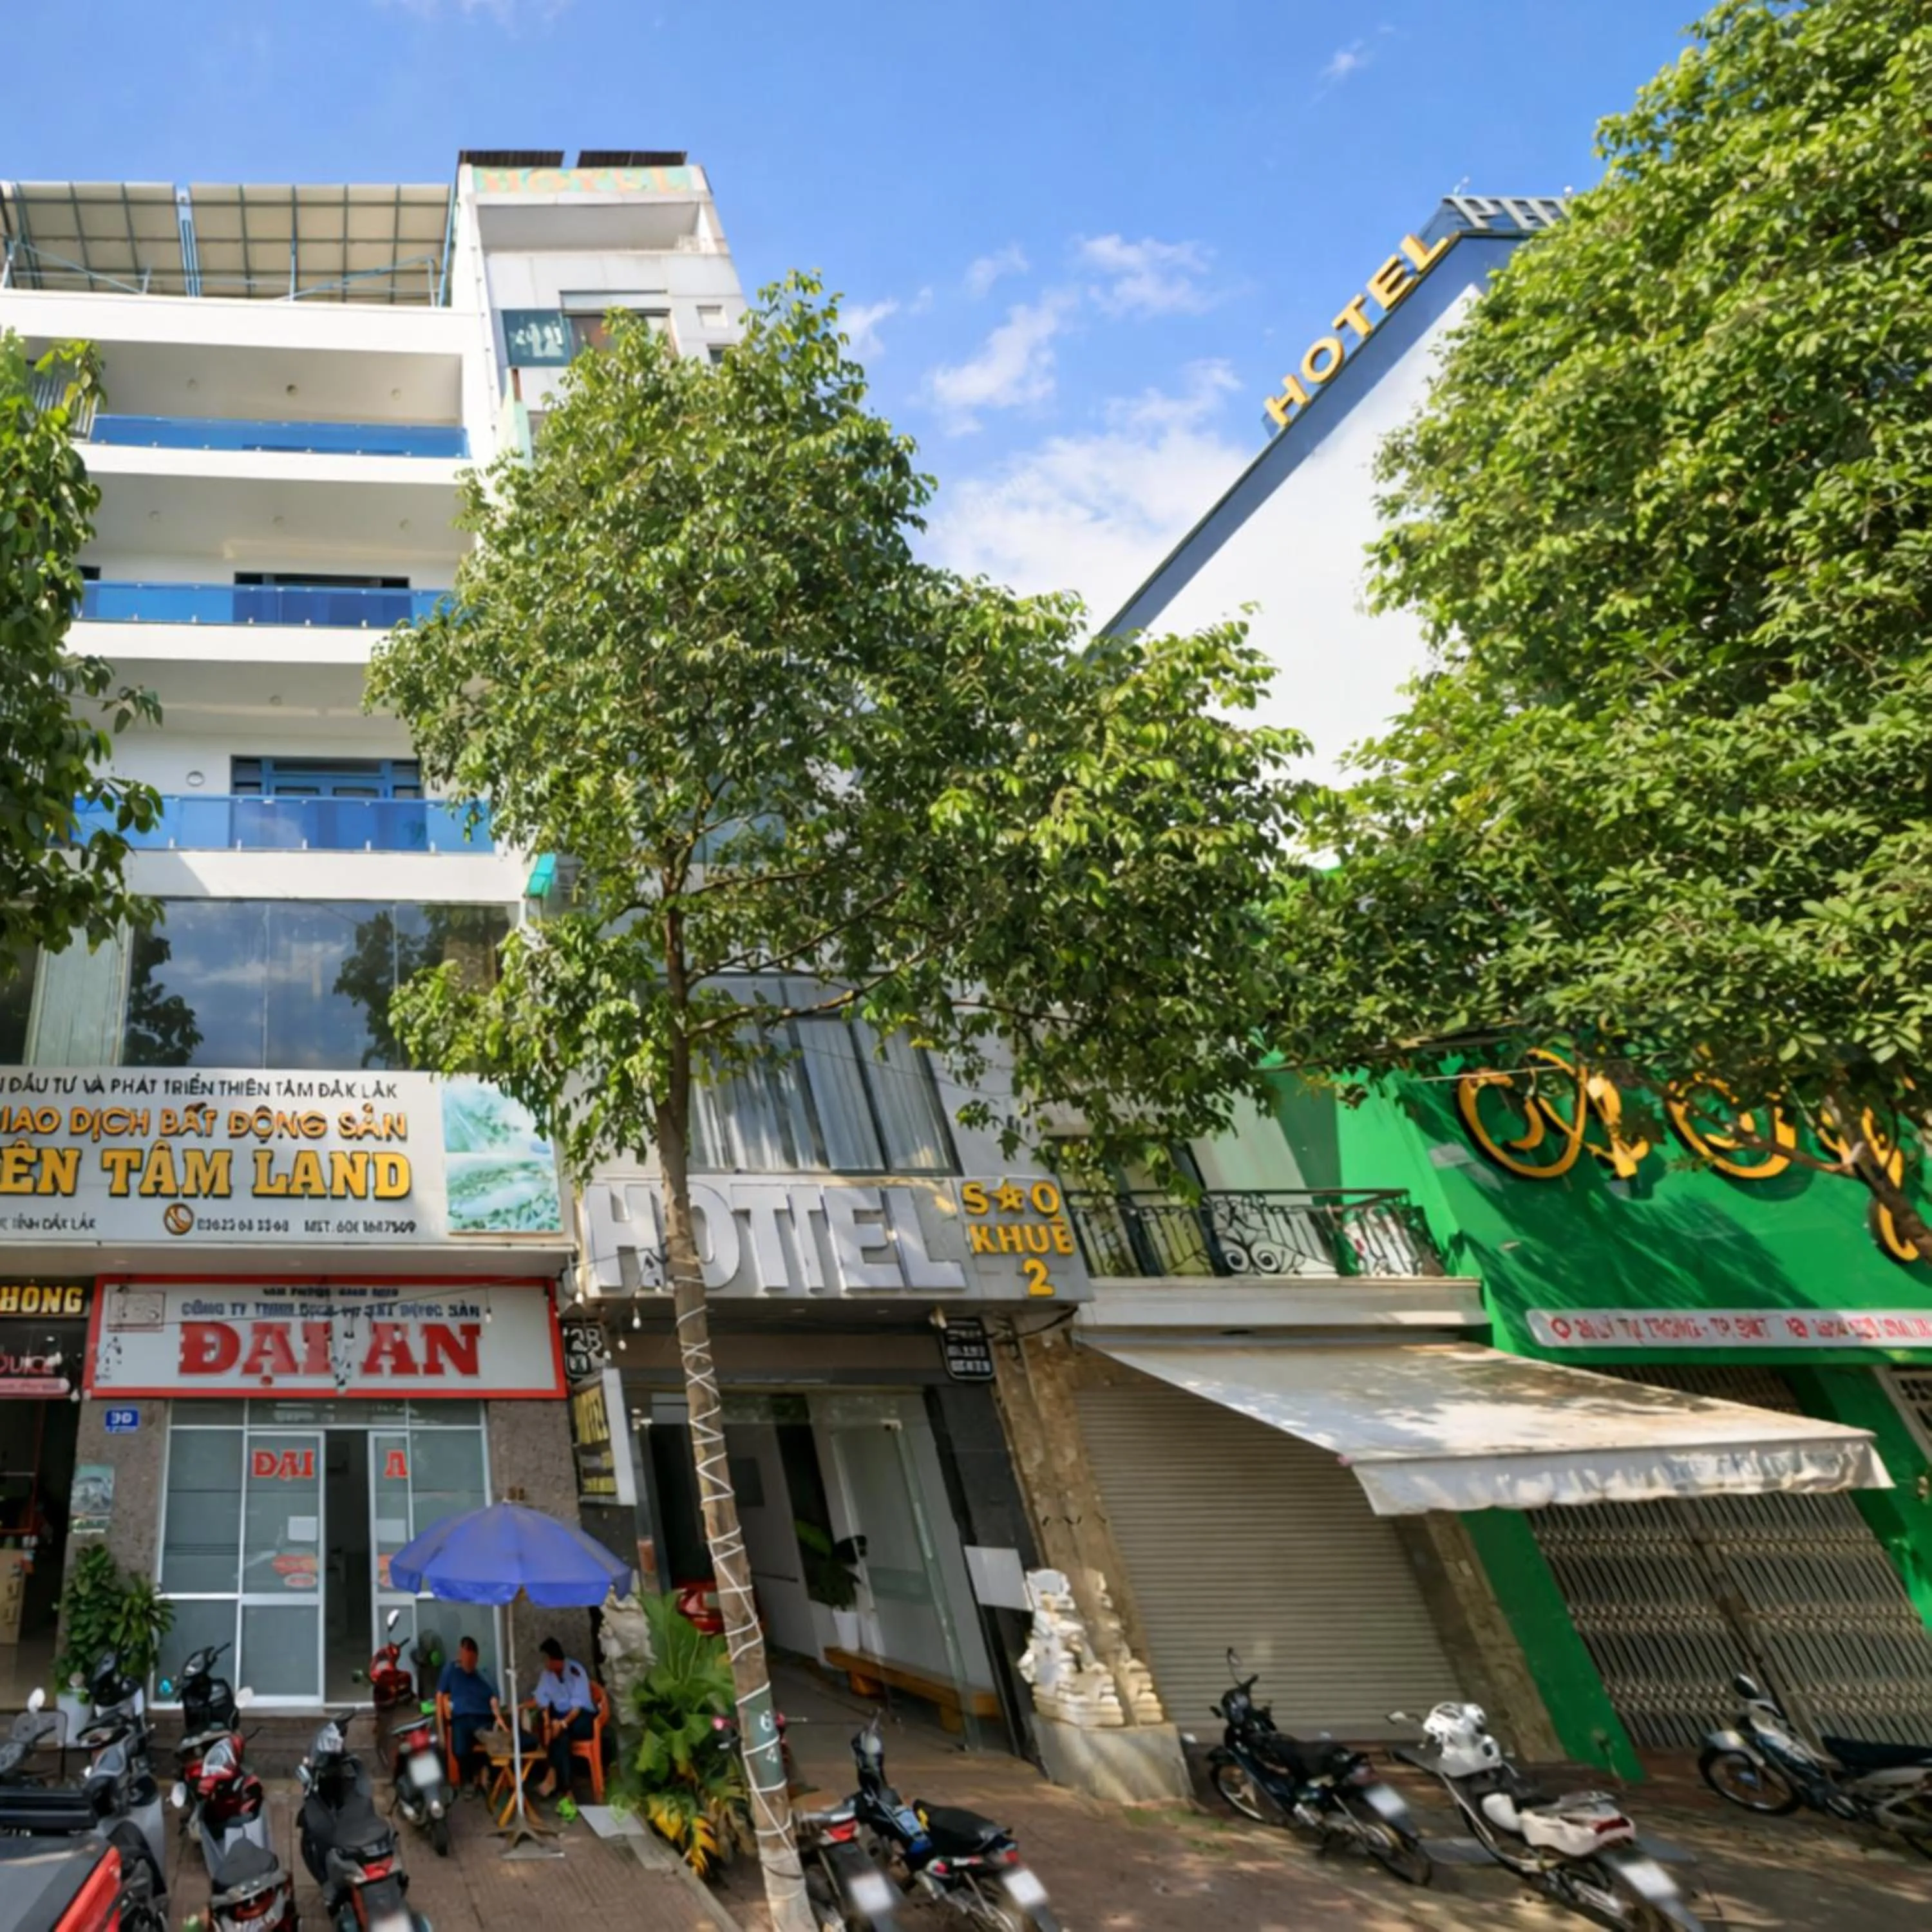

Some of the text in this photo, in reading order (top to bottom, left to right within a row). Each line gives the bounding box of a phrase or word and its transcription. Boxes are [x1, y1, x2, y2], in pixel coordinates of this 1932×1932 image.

[1264, 234, 1449, 426] HOTEL
[69, 1106, 151, 1143] DỊCH
[160, 1102, 218, 1139] BẤT
[338, 1102, 408, 1142] SẢN
[101, 1138, 232, 1198] TÂM
[252, 1150, 412, 1200] LAND
[969, 1214, 1076, 1255] KHUÊ
[1023, 1257, 1055, 1296] 2
[179, 1320, 481, 1387] ĐẠI AN
